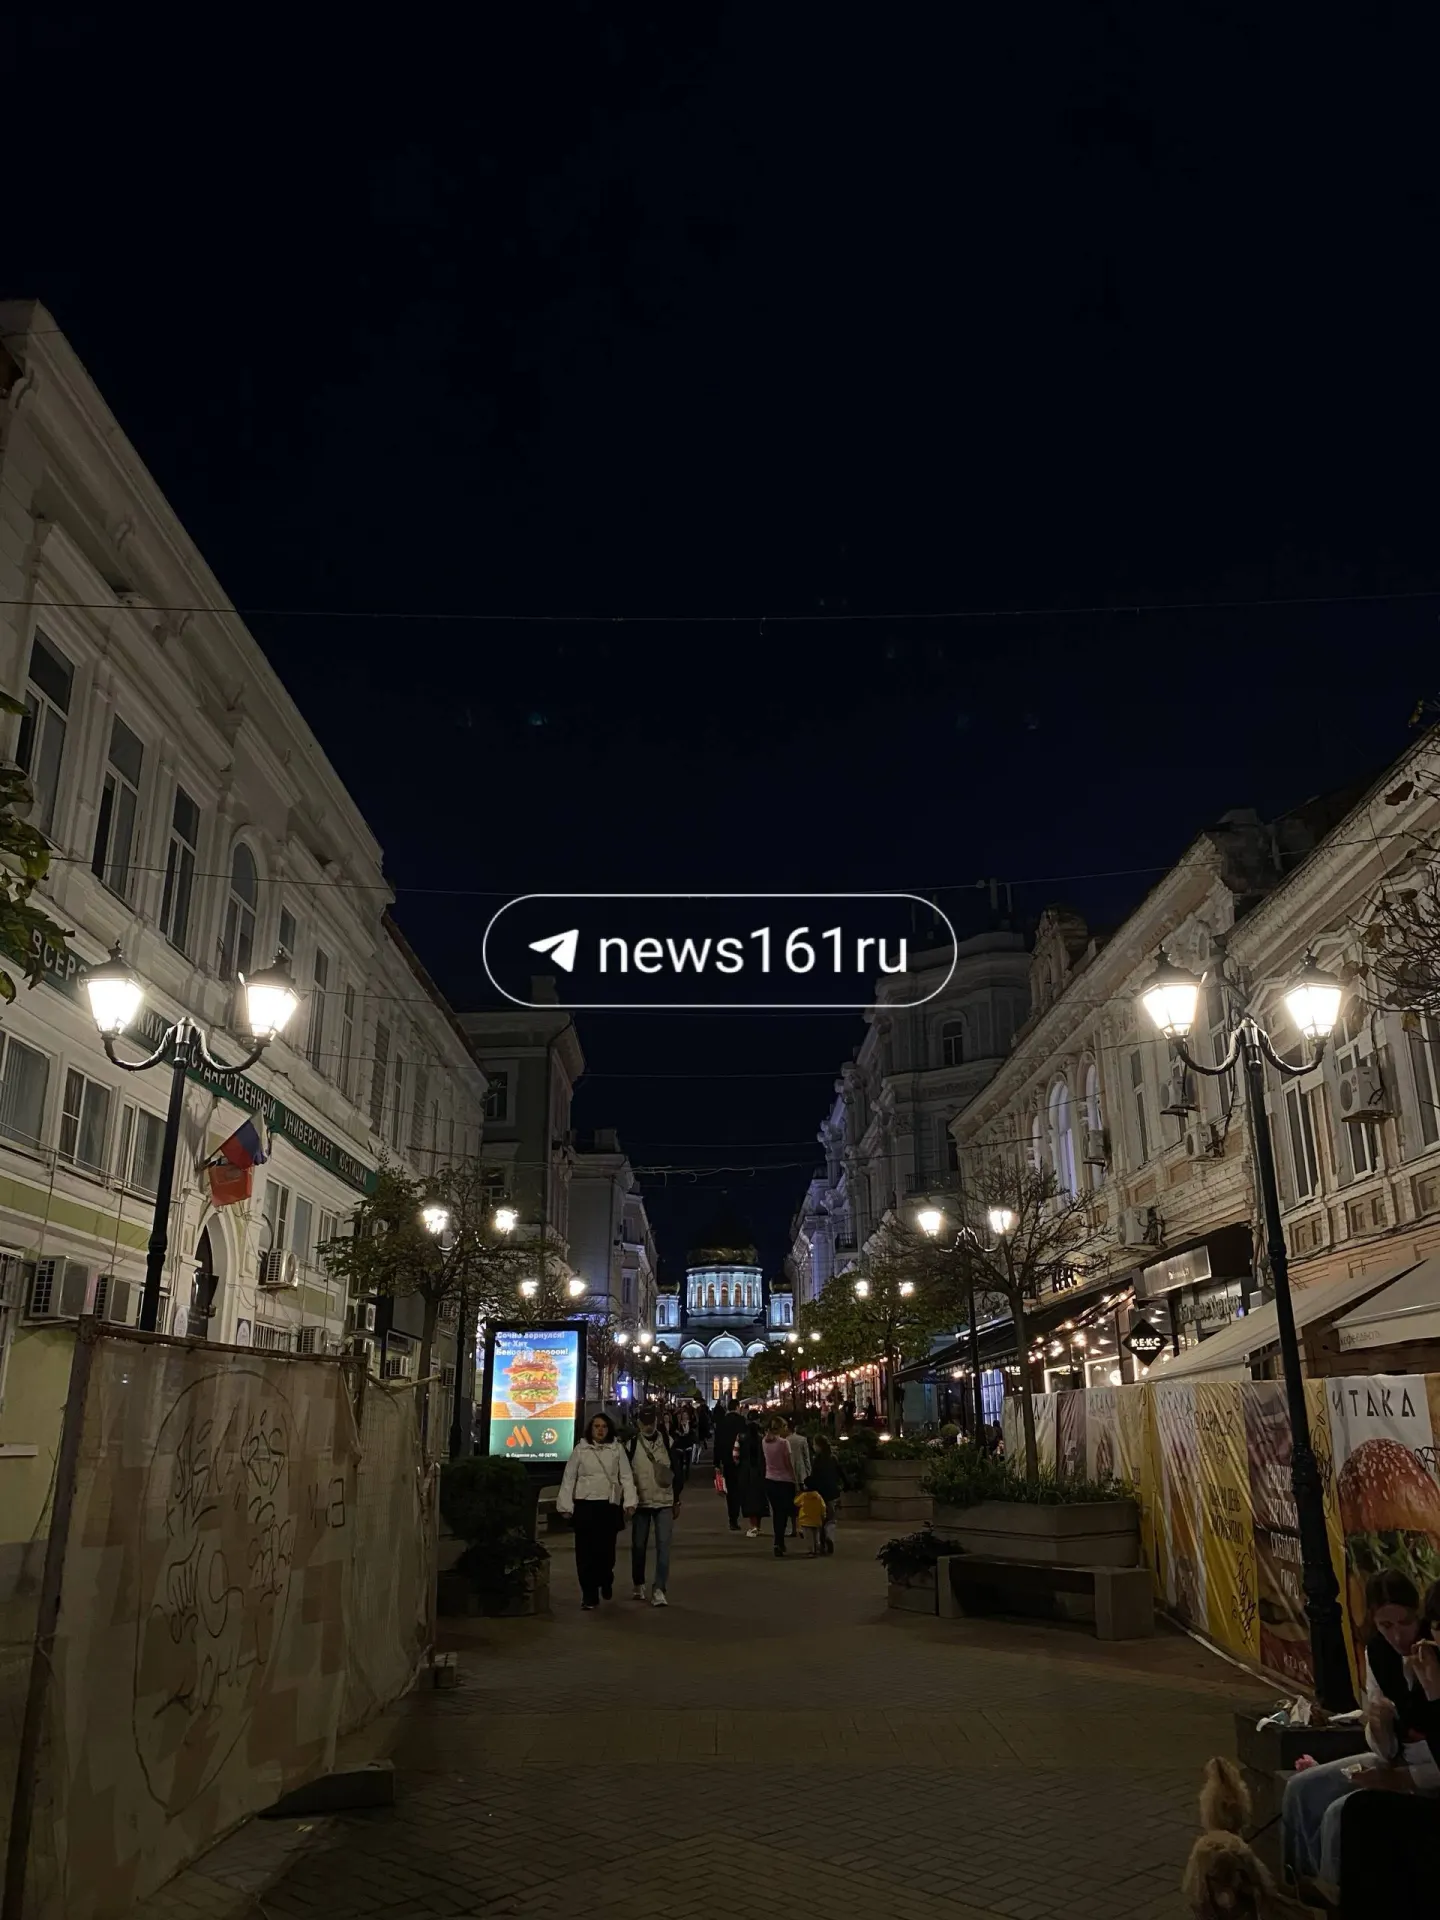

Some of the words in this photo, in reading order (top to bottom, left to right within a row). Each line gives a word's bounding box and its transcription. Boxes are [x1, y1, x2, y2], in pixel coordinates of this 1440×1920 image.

[283, 1109, 334, 1162] УНИВЕРСИТЕТ
[338, 1151, 367, 1187] ЮСТИЦИИ
[1332, 1387, 1416, 1417] ИТАКА
